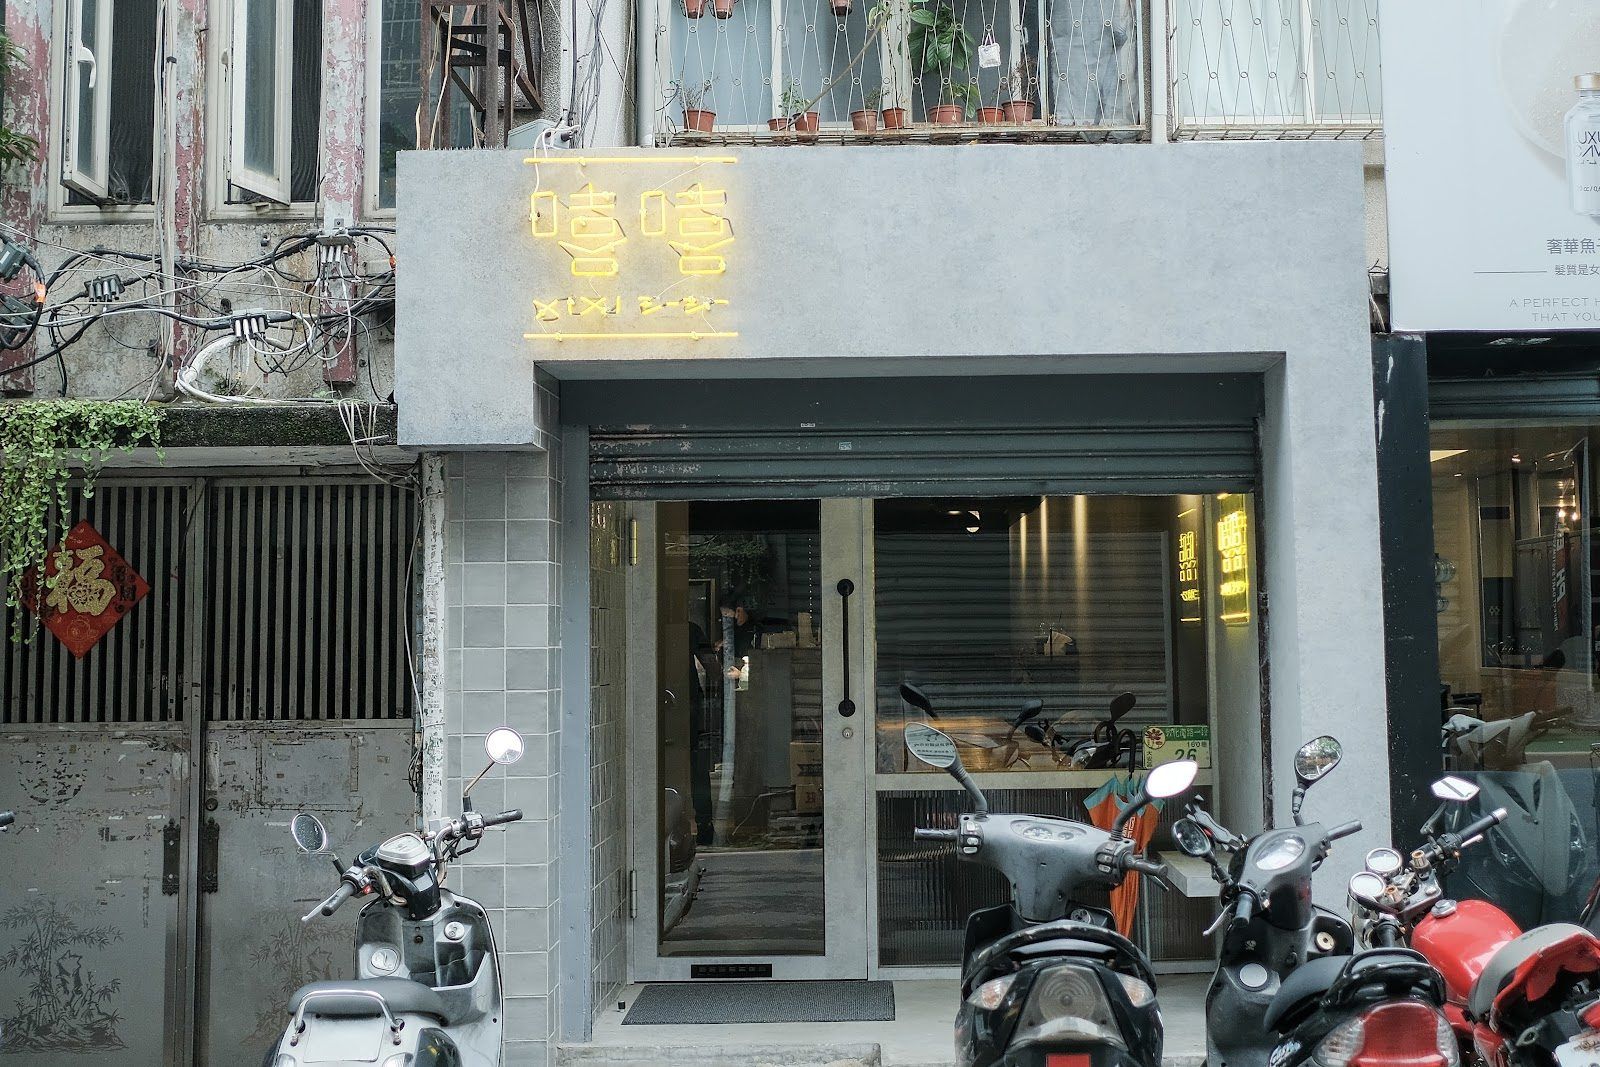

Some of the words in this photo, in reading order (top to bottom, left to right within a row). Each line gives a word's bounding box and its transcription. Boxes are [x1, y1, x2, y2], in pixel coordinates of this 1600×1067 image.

[529, 182, 735, 276] 嘻嘻
[1547, 238, 1600, 255] 奢華魚
[533, 296, 621, 320] XIXI
[1509, 299, 1518, 307] A
[1523, 298, 1589, 307] PERFECT
[1532, 312, 1567, 321] THAT
[46, 544, 117, 616] 福
